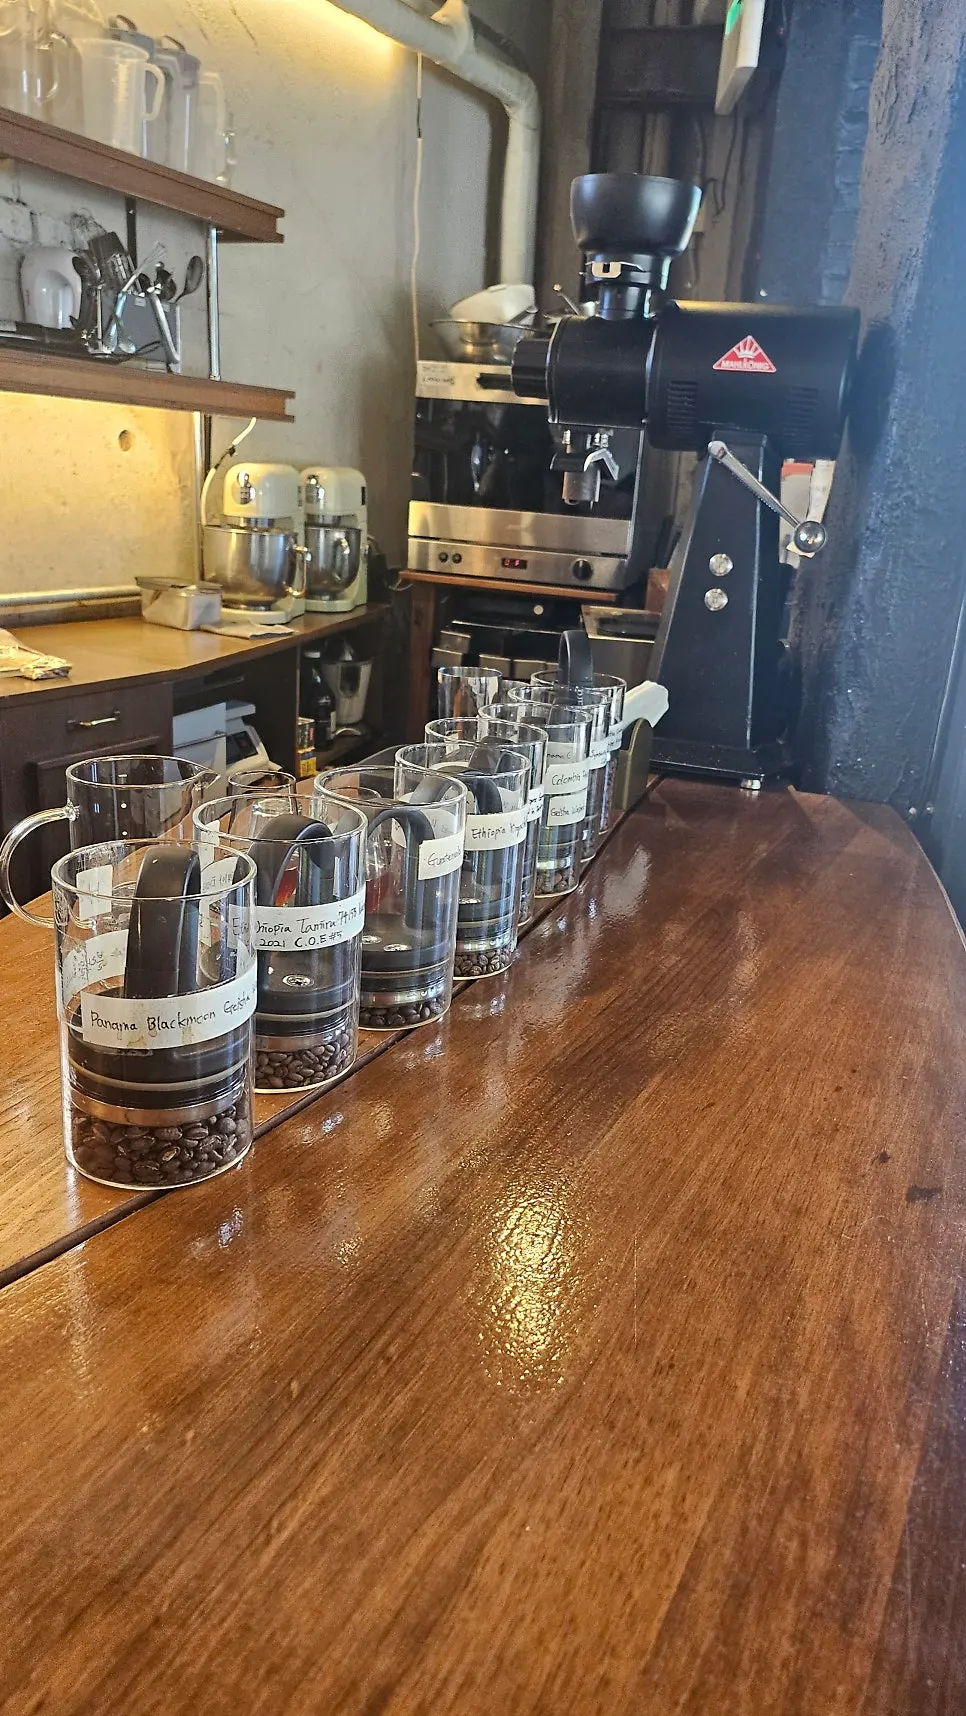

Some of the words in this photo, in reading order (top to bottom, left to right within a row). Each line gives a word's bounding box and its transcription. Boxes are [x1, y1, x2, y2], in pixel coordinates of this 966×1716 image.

[472, 826, 506, 841] Ethiopia
[259, 938, 286, 948] 2021
[90, 1009, 138, 1031] Panama
